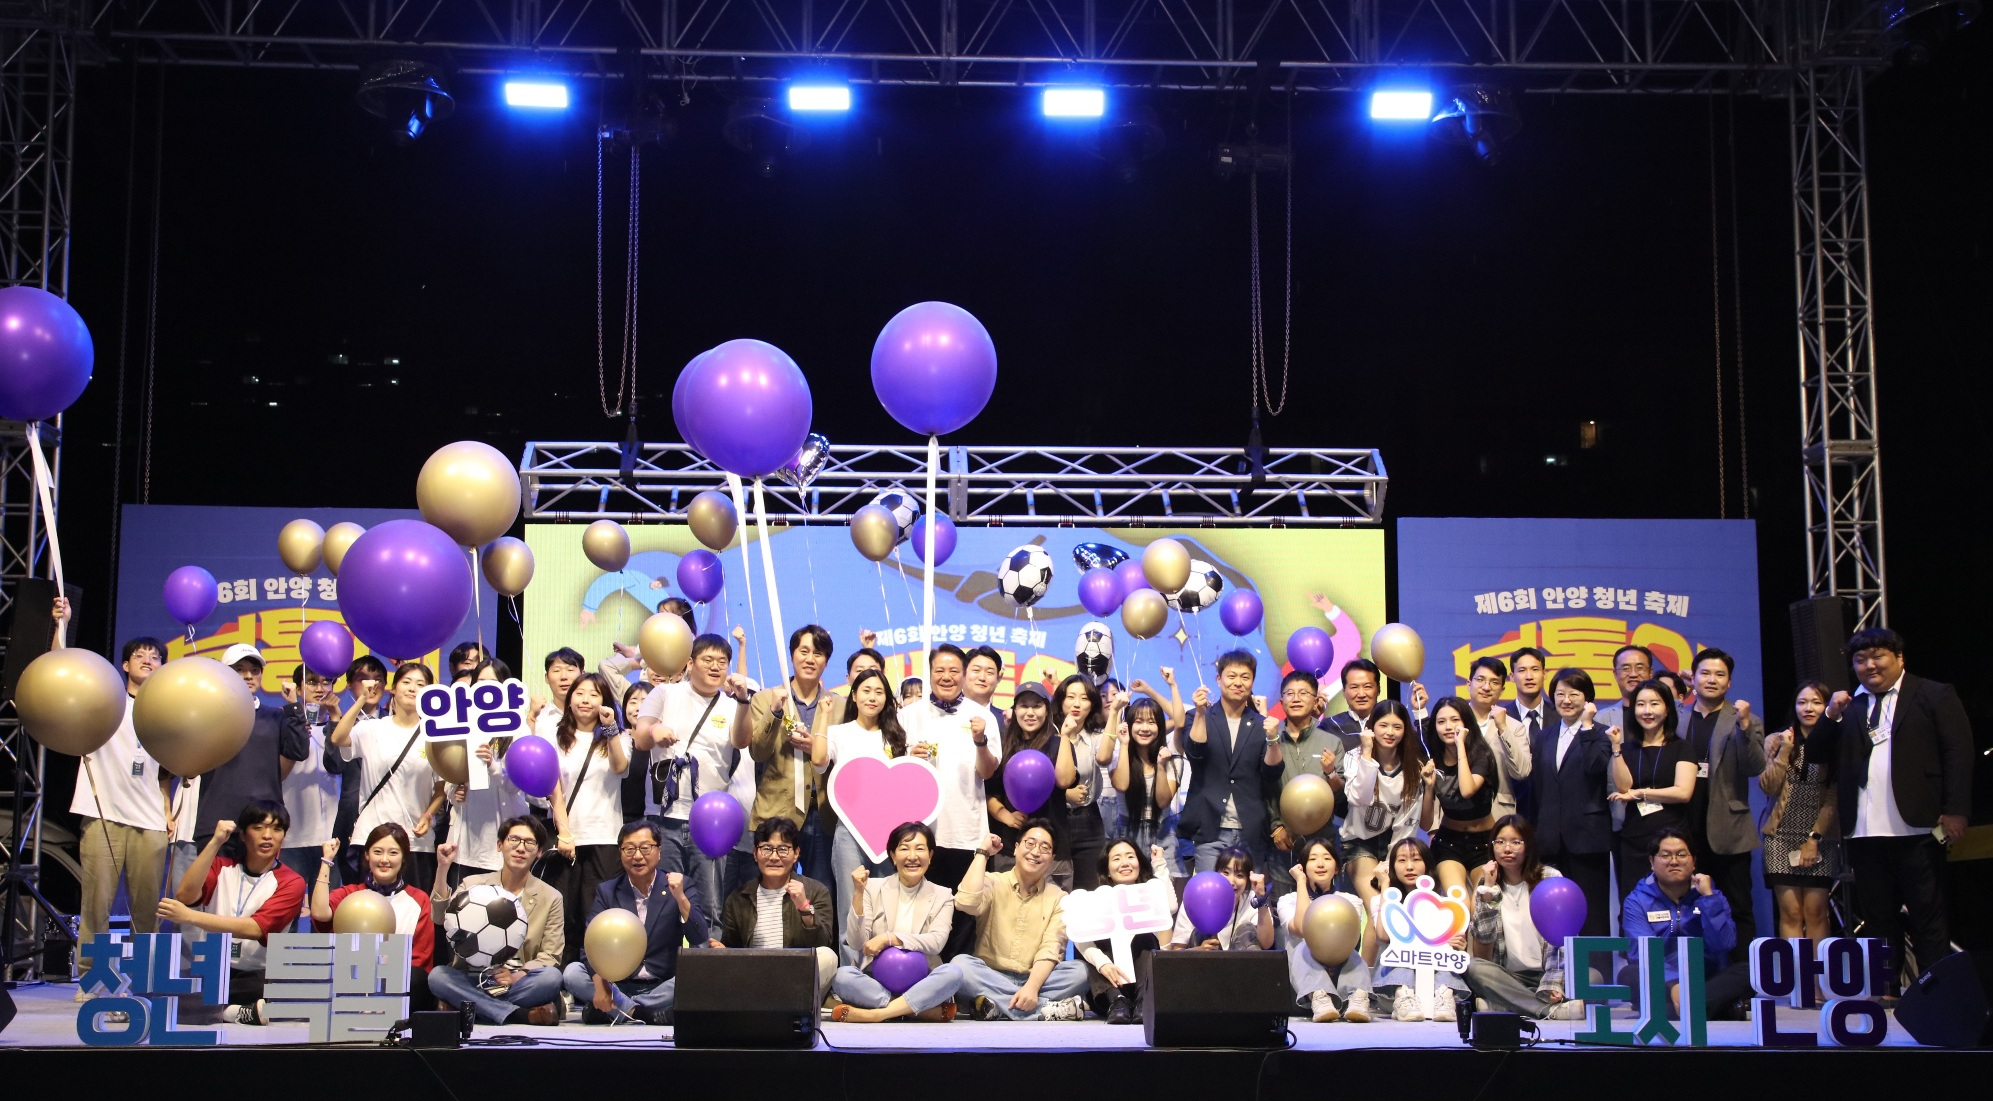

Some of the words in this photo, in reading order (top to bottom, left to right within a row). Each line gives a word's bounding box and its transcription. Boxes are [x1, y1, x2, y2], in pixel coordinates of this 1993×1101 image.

[217, 579, 258, 604] 6회
[263, 576, 313, 600] 안양
[317, 577, 338, 601] 청
[1473, 587, 1537, 615] 제6회
[1542, 586, 1589, 609] 안양
[1593, 586, 1638, 611] 청년
[1643, 590, 1690, 618] 축제
[875, 625, 926, 647] 제6회
[930, 624, 967, 643] 안양
[970, 624, 1006, 644] 청년
[1010, 627, 1047, 649] 축제
[420, 683, 525, 738] 안양
[1384, 949, 1467, 970] 스마트안양
[76, 932, 228, 1046] 청년
[262, 932, 411, 1044] 특별
[1568, 936, 1708, 1046] 도시
[1752, 936, 1893, 1047] 안양
